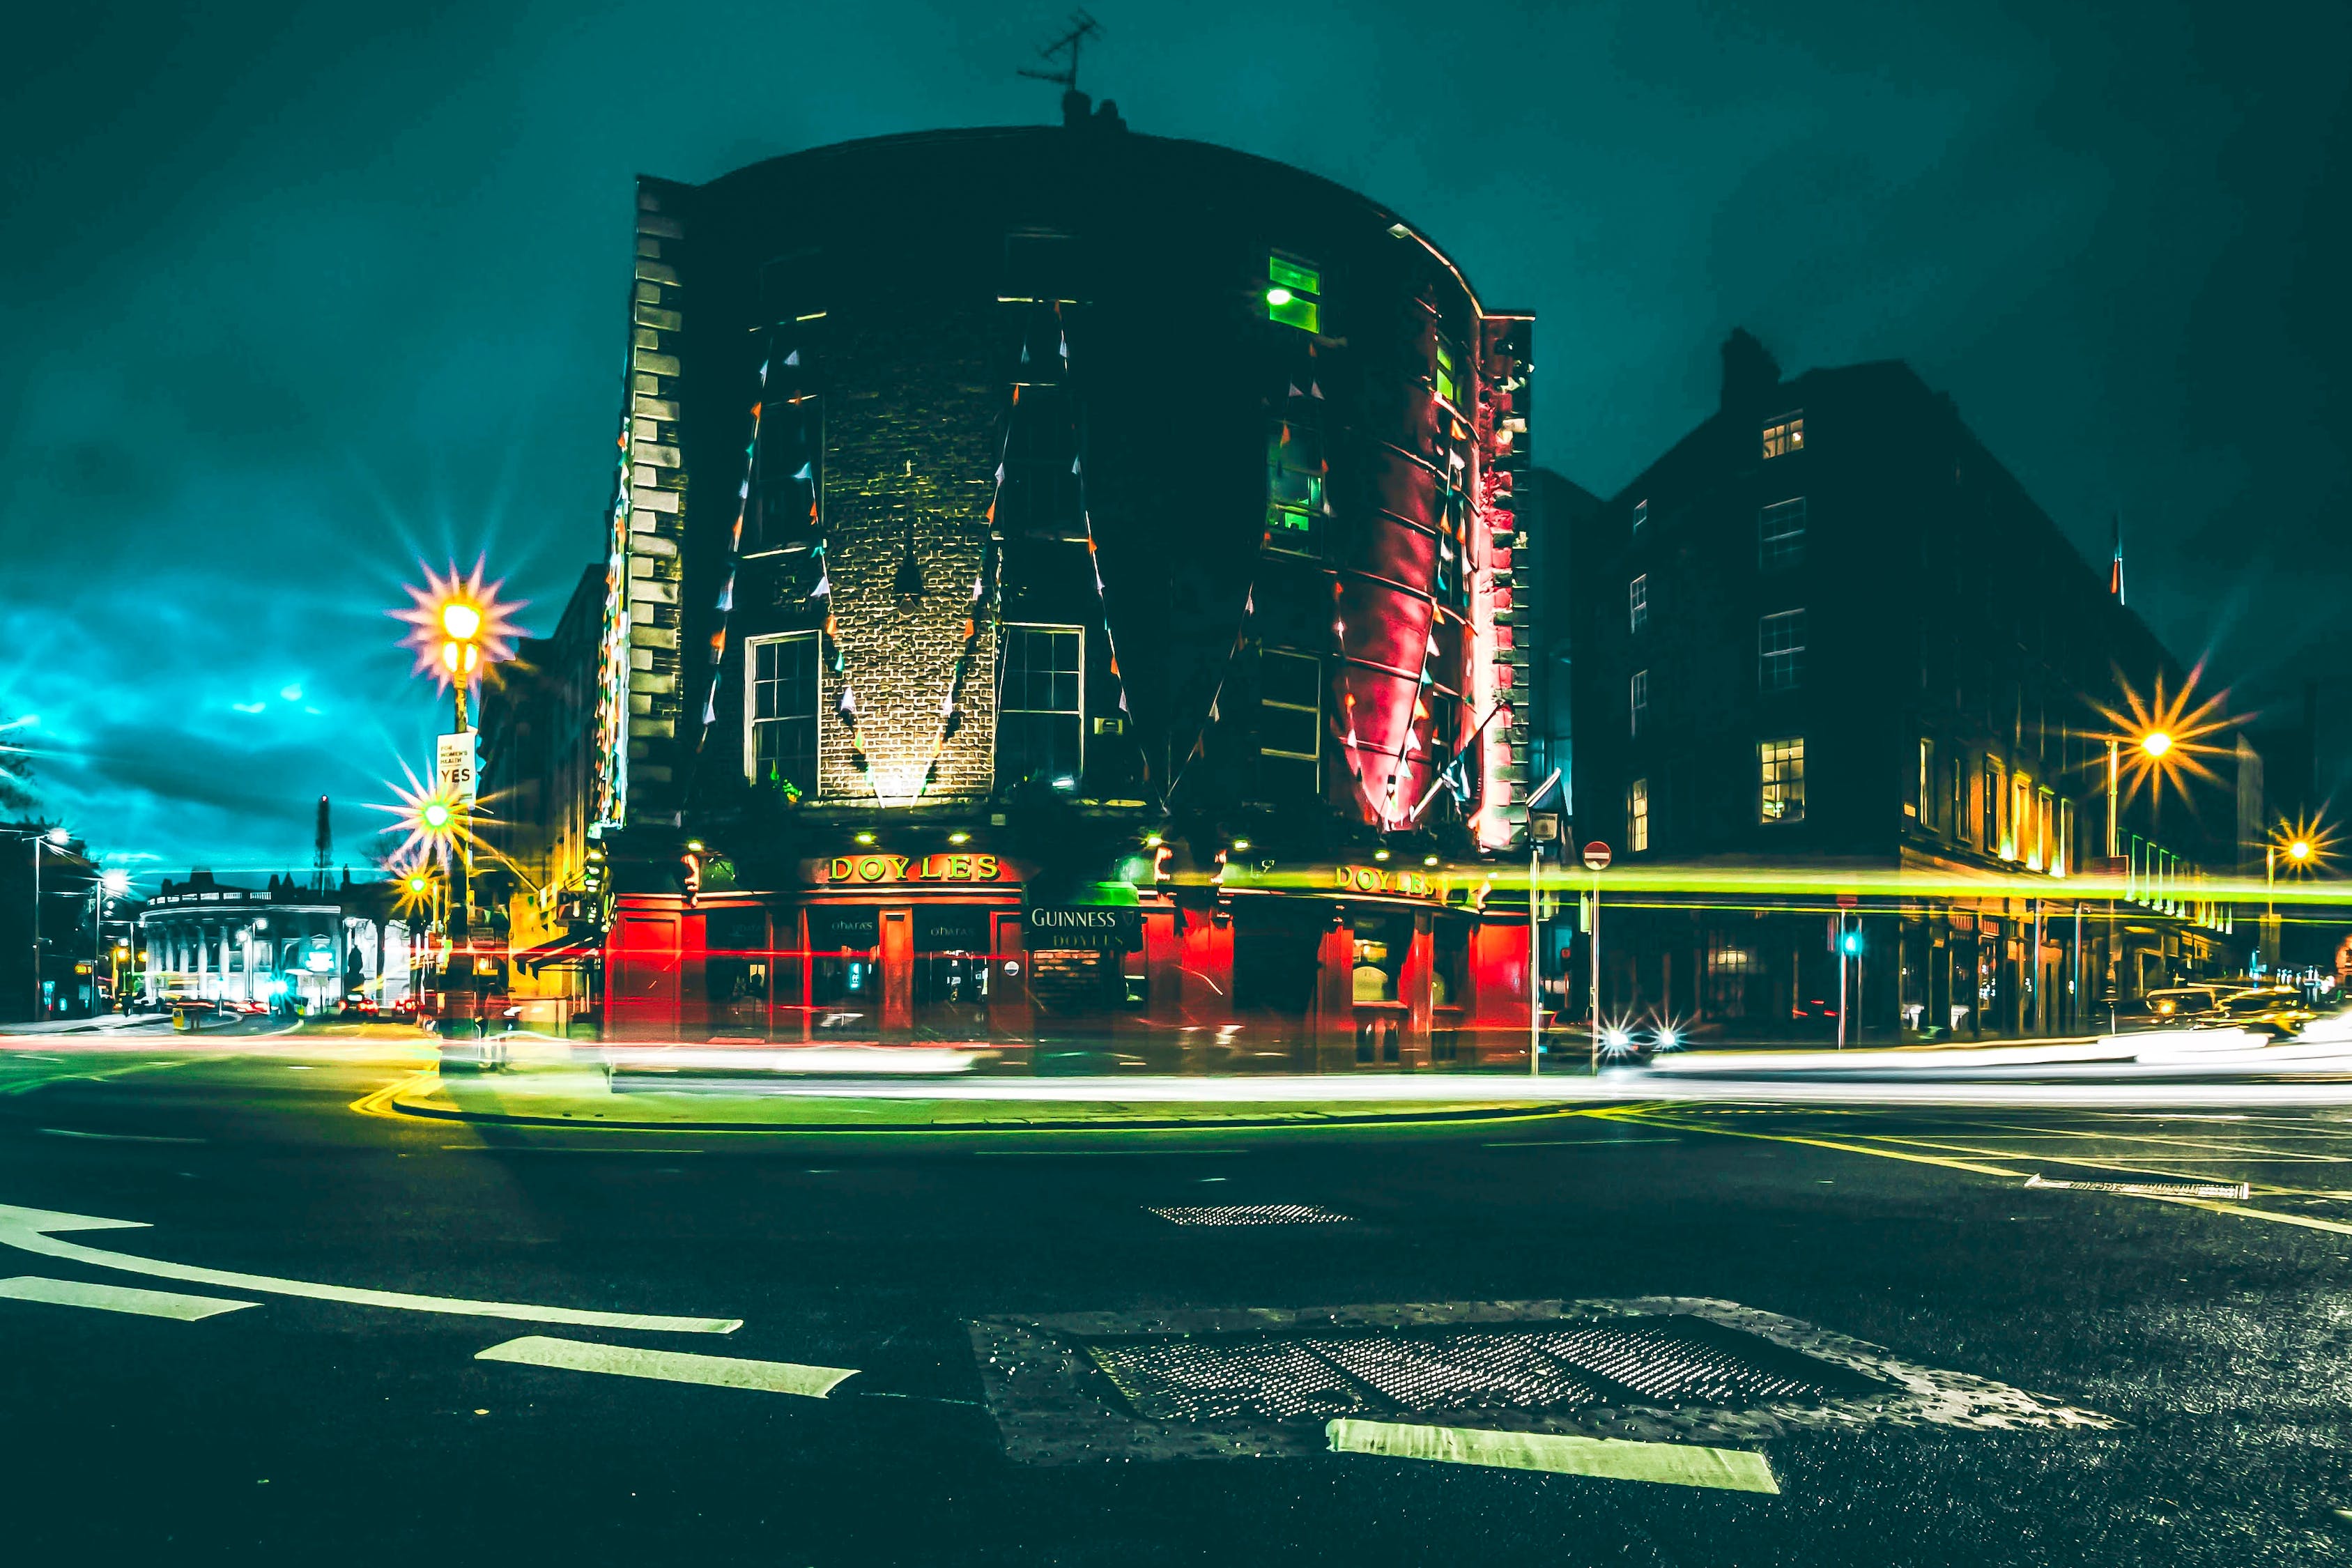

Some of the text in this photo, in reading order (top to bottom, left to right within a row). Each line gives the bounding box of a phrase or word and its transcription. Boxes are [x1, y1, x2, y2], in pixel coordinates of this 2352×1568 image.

[441, 769, 470, 783] YES
[829, 856, 999, 880] DOYLES
[1335, 866, 1437, 896] DOYLES
[1031, 907, 1116, 928] GUINNESS
